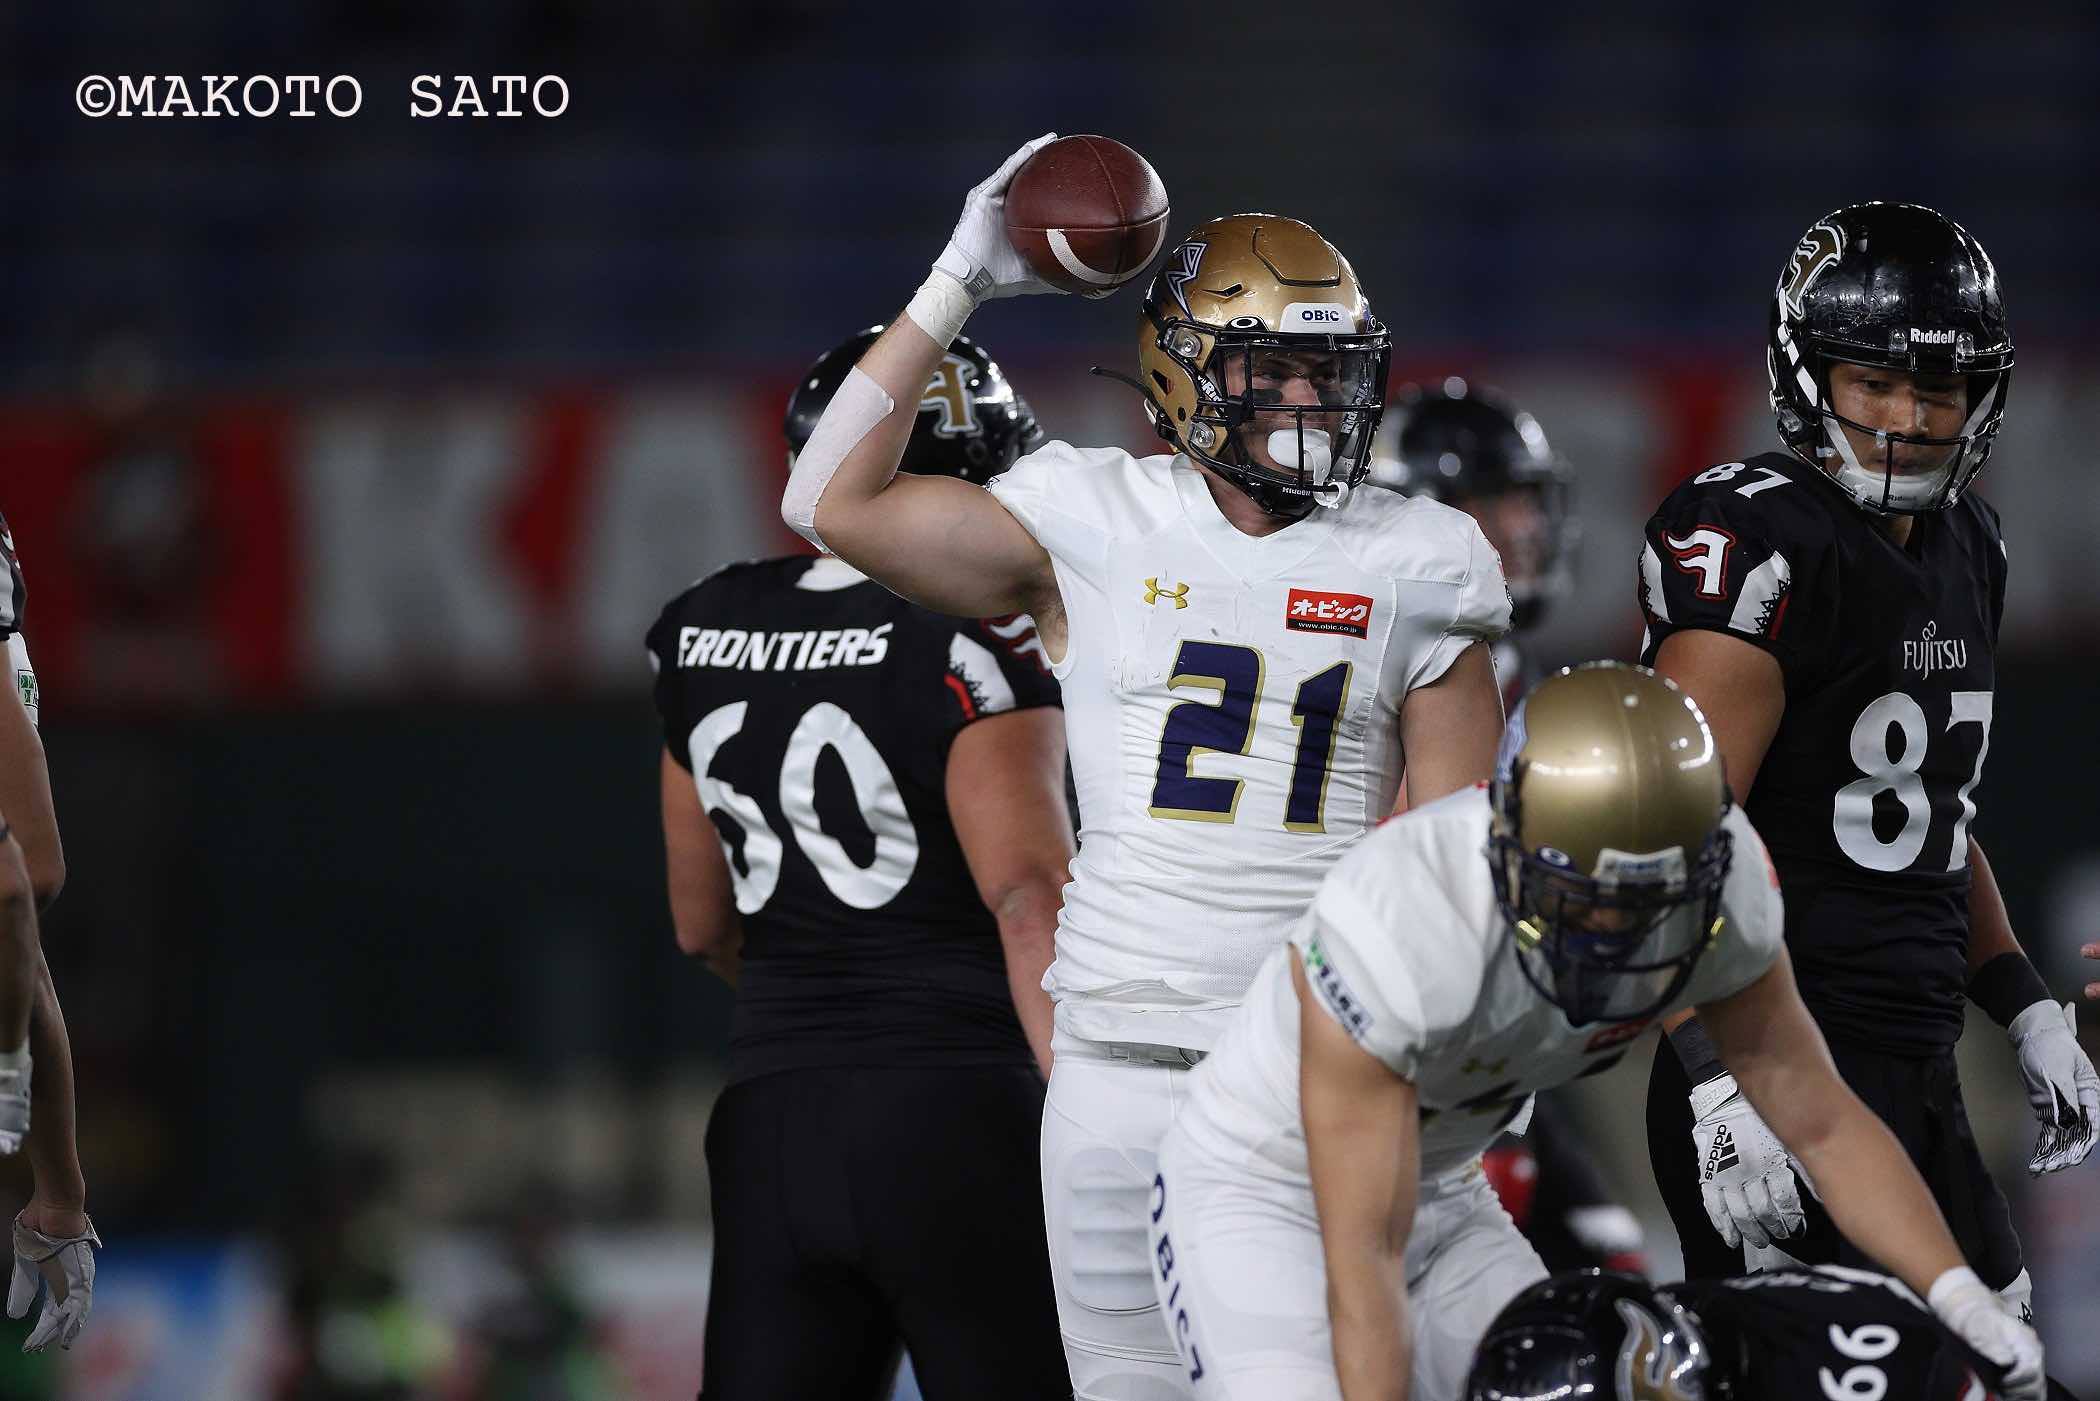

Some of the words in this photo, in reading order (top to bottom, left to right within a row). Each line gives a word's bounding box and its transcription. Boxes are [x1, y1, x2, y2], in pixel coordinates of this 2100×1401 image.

[1910, 327, 1956, 345] Riddell
[1694, 463, 1792, 498] 87
[1290, 599, 1368, 621] オービック
[678, 623, 893, 670] FRONTIERS
[1903, 634, 1967, 680] FUJITSU
[1147, 639, 1353, 834] 21
[1833, 691, 1994, 872] 87
[688, 700, 919, 915] 60
[1704, 1124, 1727, 1181] adidas
